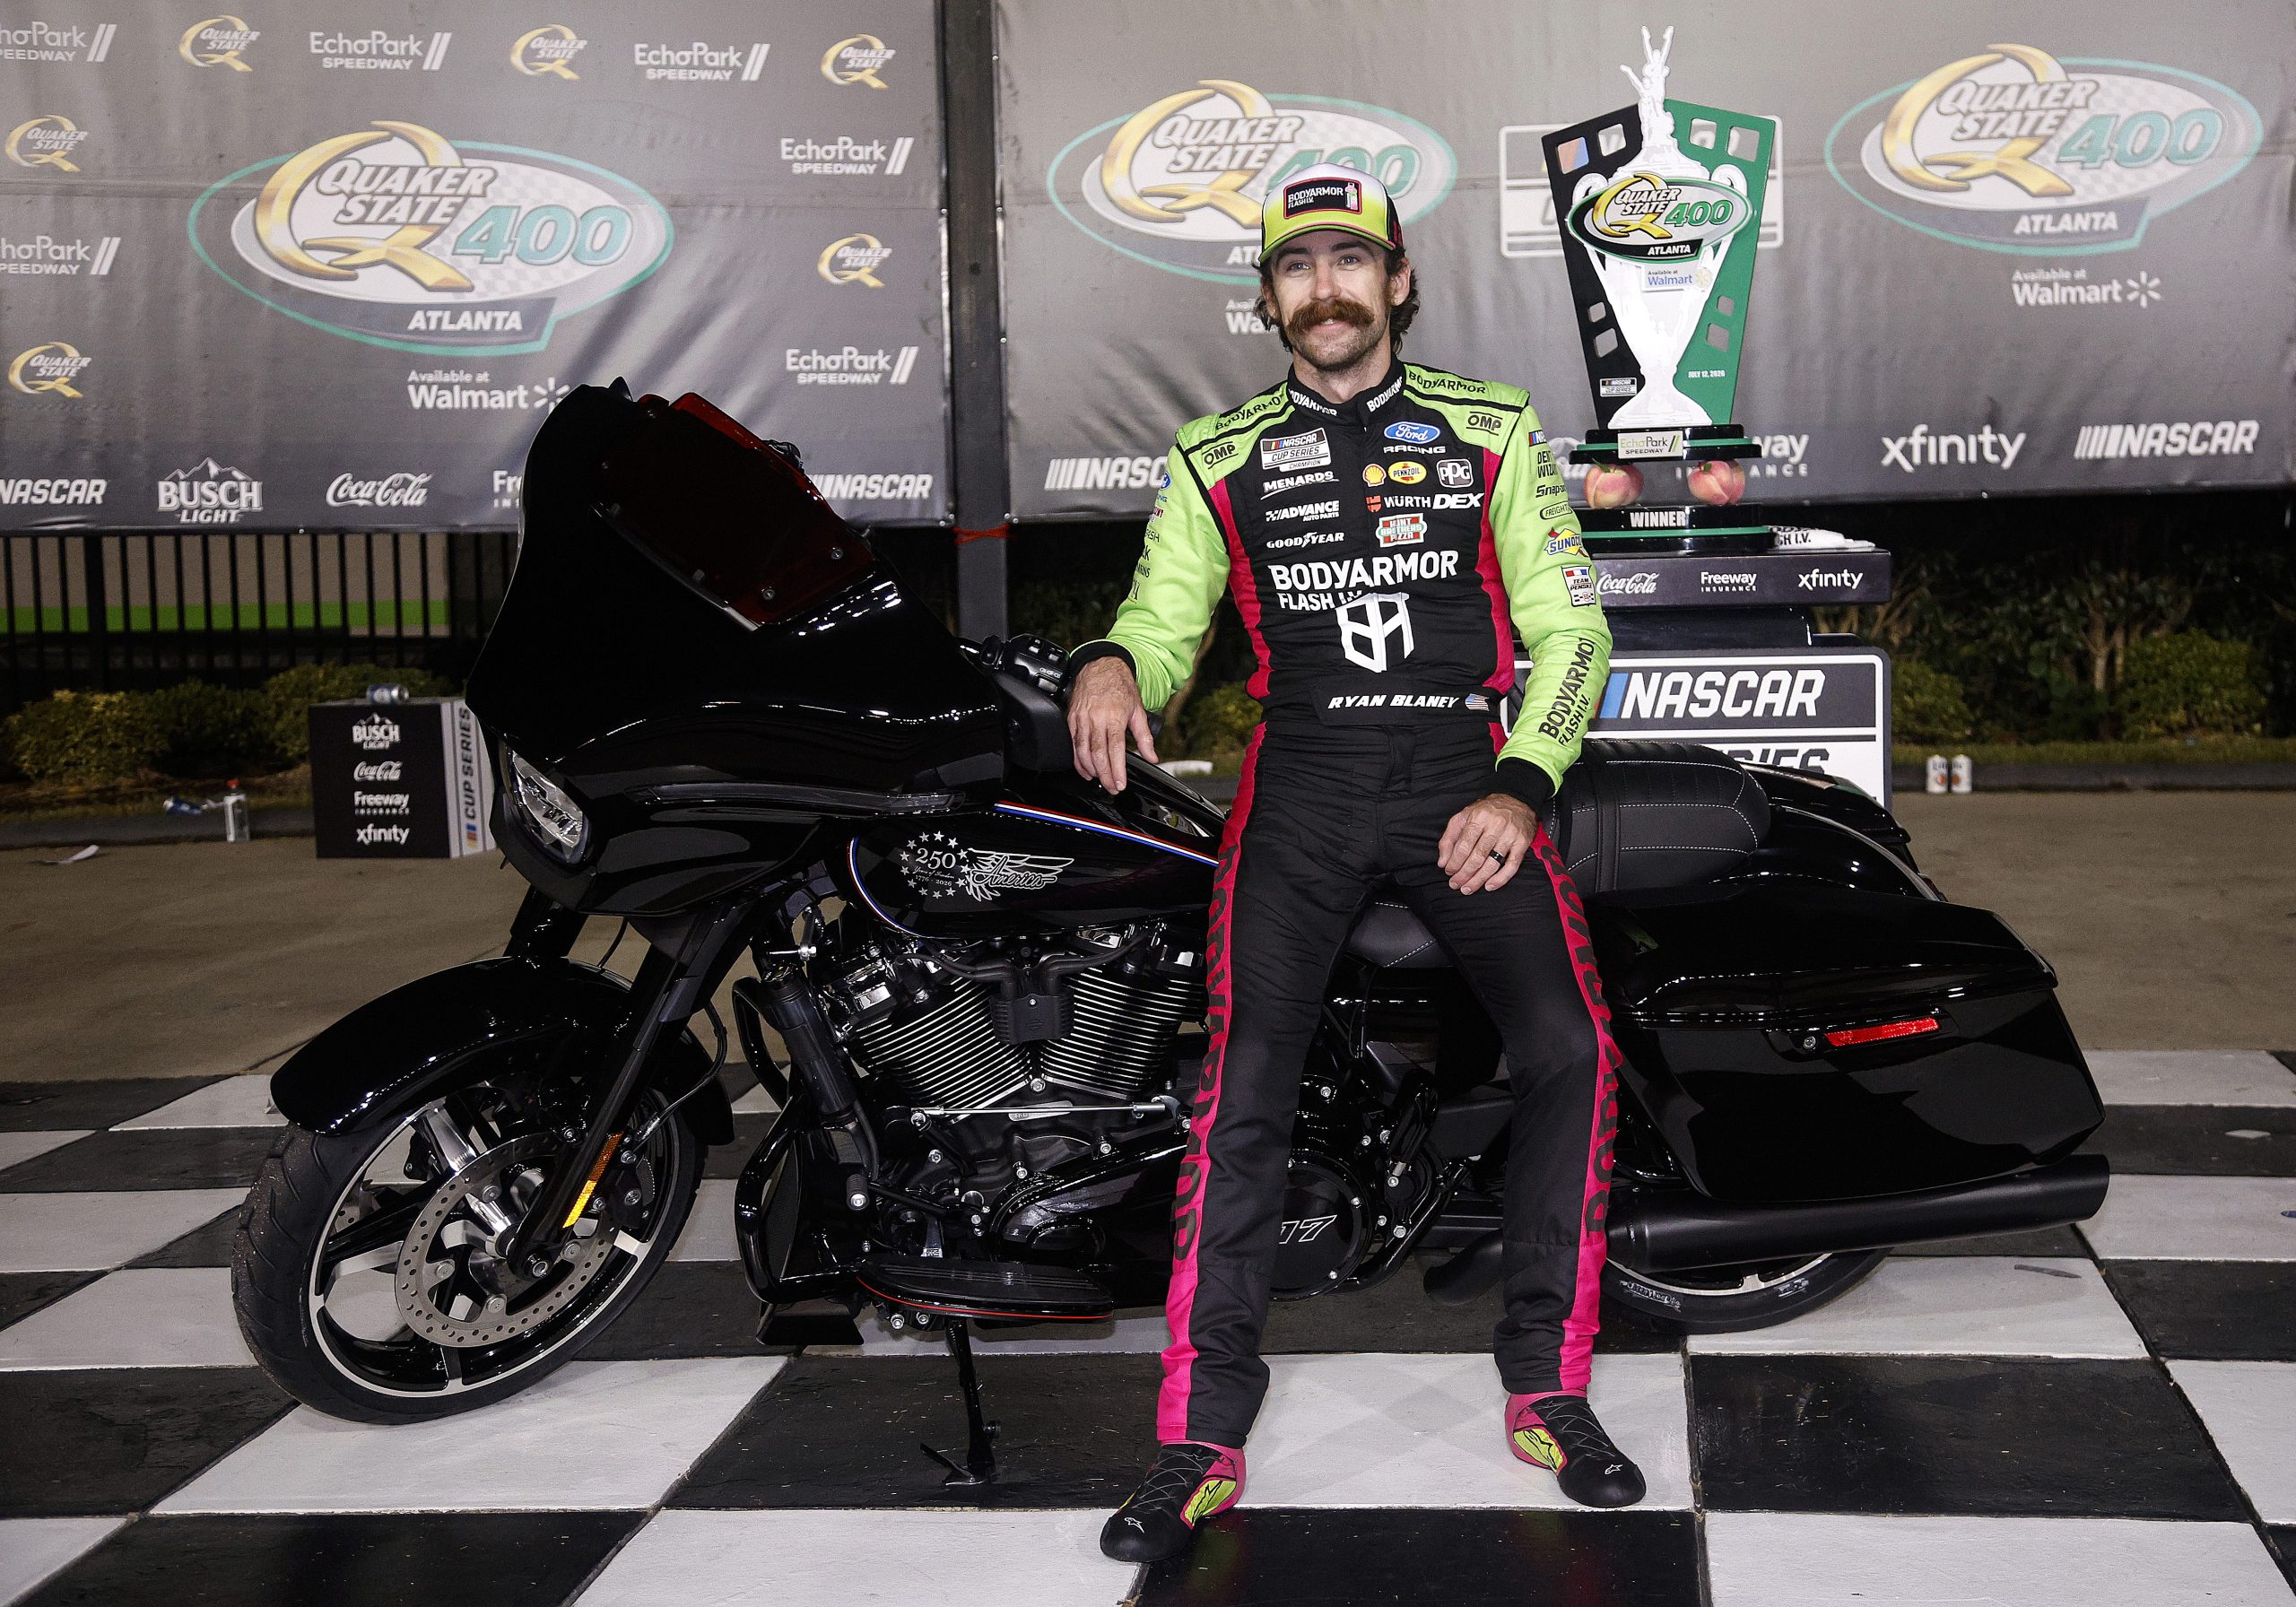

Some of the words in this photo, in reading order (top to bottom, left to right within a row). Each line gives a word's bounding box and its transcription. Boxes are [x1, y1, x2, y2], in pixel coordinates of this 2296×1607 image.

[201, 27, 260, 41] QUAKER
[207, 39, 248, 51] STATE
[310, 31, 423, 57] EchoPark
[530, 36, 587, 49] QUAKER
[0, 48, 76, 62] EEDWAY
[537, 47, 575, 58] STATE
[635, 42, 743, 68] EchoPark
[839, 46, 895, 59] QUAKER
[323, 57, 413, 70] SPEEDWAY
[847, 57, 884, 69] STATE
[646, 68, 733, 81] SPEEDWAY
[1936, 80, 2099, 114] QUAKER
[26, 127, 88, 142] QUAKER
[1152, 115, 1305, 148] QUAKER
[1952, 109, 2065, 141] STATE
[2057, 108, 2226, 169] 400
[33, 139, 75, 151] STATE
[781, 136, 885, 162] EchoPark
[1167, 143, 1277, 173] STATE
[792, 162, 877, 175] SPEEDWAY
[316, 159, 499, 197] QUAKER
[1288, 187, 1344, 202] BODYARMOR
[1613, 188, 1680, 204] QUAKER
[1622, 202, 1667, 215] STATE
[1665, 200, 1733, 227] 400
[335, 194, 463, 225] STATE
[452, 204, 632, 265] 400
[2013, 213, 2118, 234] ATLANTA
[0, 235, 91, 261] hoPark
[836, 245, 892, 259] QUAKER
[1648, 245, 1691, 255] ATLANTA
[0, 263, 81, 274] PEEDWAY
[843, 256, 881, 267] STATE
[1648, 274, 1692, 286] Walmart
[2012, 270, 2071, 282] Available
[2073, 269, 2086, 281] at
[2012, 281, 2121, 307] Walmart
[407, 310, 522, 331] ATLANTA
[30, 354, 91, 369] QUAKER
[787, 347, 891, 372] EchoPark
[36, 366, 78, 378] STATE
[407, 370, 473, 384] Available
[477, 371, 489, 384] at
[797, 372, 882, 384] SPEEDWAY
[1409, 370, 1486, 394] BODYARMOR
[407, 384, 528, 410] Walmart
[1468, 414, 1502, 430] OMP
[1282, 434, 1318, 447] NASCAR
[1395, 424, 1430, 442] Ford
[2119, 420, 2259, 457] NASCAR
[1384, 445, 1446, 455] RACING
[1621, 437, 1667, 448] EchoPark
[1882, 424, 2026, 473] xfinity
[1205, 445, 1235, 465] OMP
[1272, 450, 1288, 461] CUP
[1290, 447, 1319, 458] SERIES
[1085, 456, 1168, 489] NASC
[1290, 460, 1321, 469] CHAMPION
[1394, 467, 1421, 477] PENNZOIL
[831, 473, 932, 499] NASCAR
[1264, 471, 1334, 492] MENARDS
[158, 481, 263, 511] BUSCH
[326, 473, 432, 507] Coca-Cola
[1432, 493, 1484, 509] DEX
[180, 509, 239, 523] LIGHT
[1280, 500, 1339, 519] ADVANCE
[1320, 511, 1339, 519] PARTS
[1390, 517, 1412, 527] HUNT
[1631, 511, 1686, 527] WINNER
[1380, 524, 1422, 536] BROTHERS
[1391, 532, 1413, 541] PIZZA
[1266, 533, 1344, 548] GOODYEAR
[1267, 550, 1458, 591] BODYARMOR
[1596, 573, 1659, 595] Coca-Cola
[1700, 571, 1757, 588] Freeway
[1798, 569, 1863, 589] xfinity
[1277, 592, 1335, 611] FLASH
[1327, 695, 1387, 709] RYAN
[1390, 695, 1459, 708] BLANEY
[1621, 670, 1825, 718] NASCAR
[1559, 710, 1584, 746] FLASH
[1577, 694, 1590, 712] I.V.
[352, 724, 400, 743] BUSCH
[459, 708, 474, 777] SERIES
[354, 792, 409, 808] Freeway
[462, 782, 475, 820] CUP
[356, 823, 410, 845] xfinity
[916, 847, 956, 870] 250
[971, 855, 1057, 889] America
